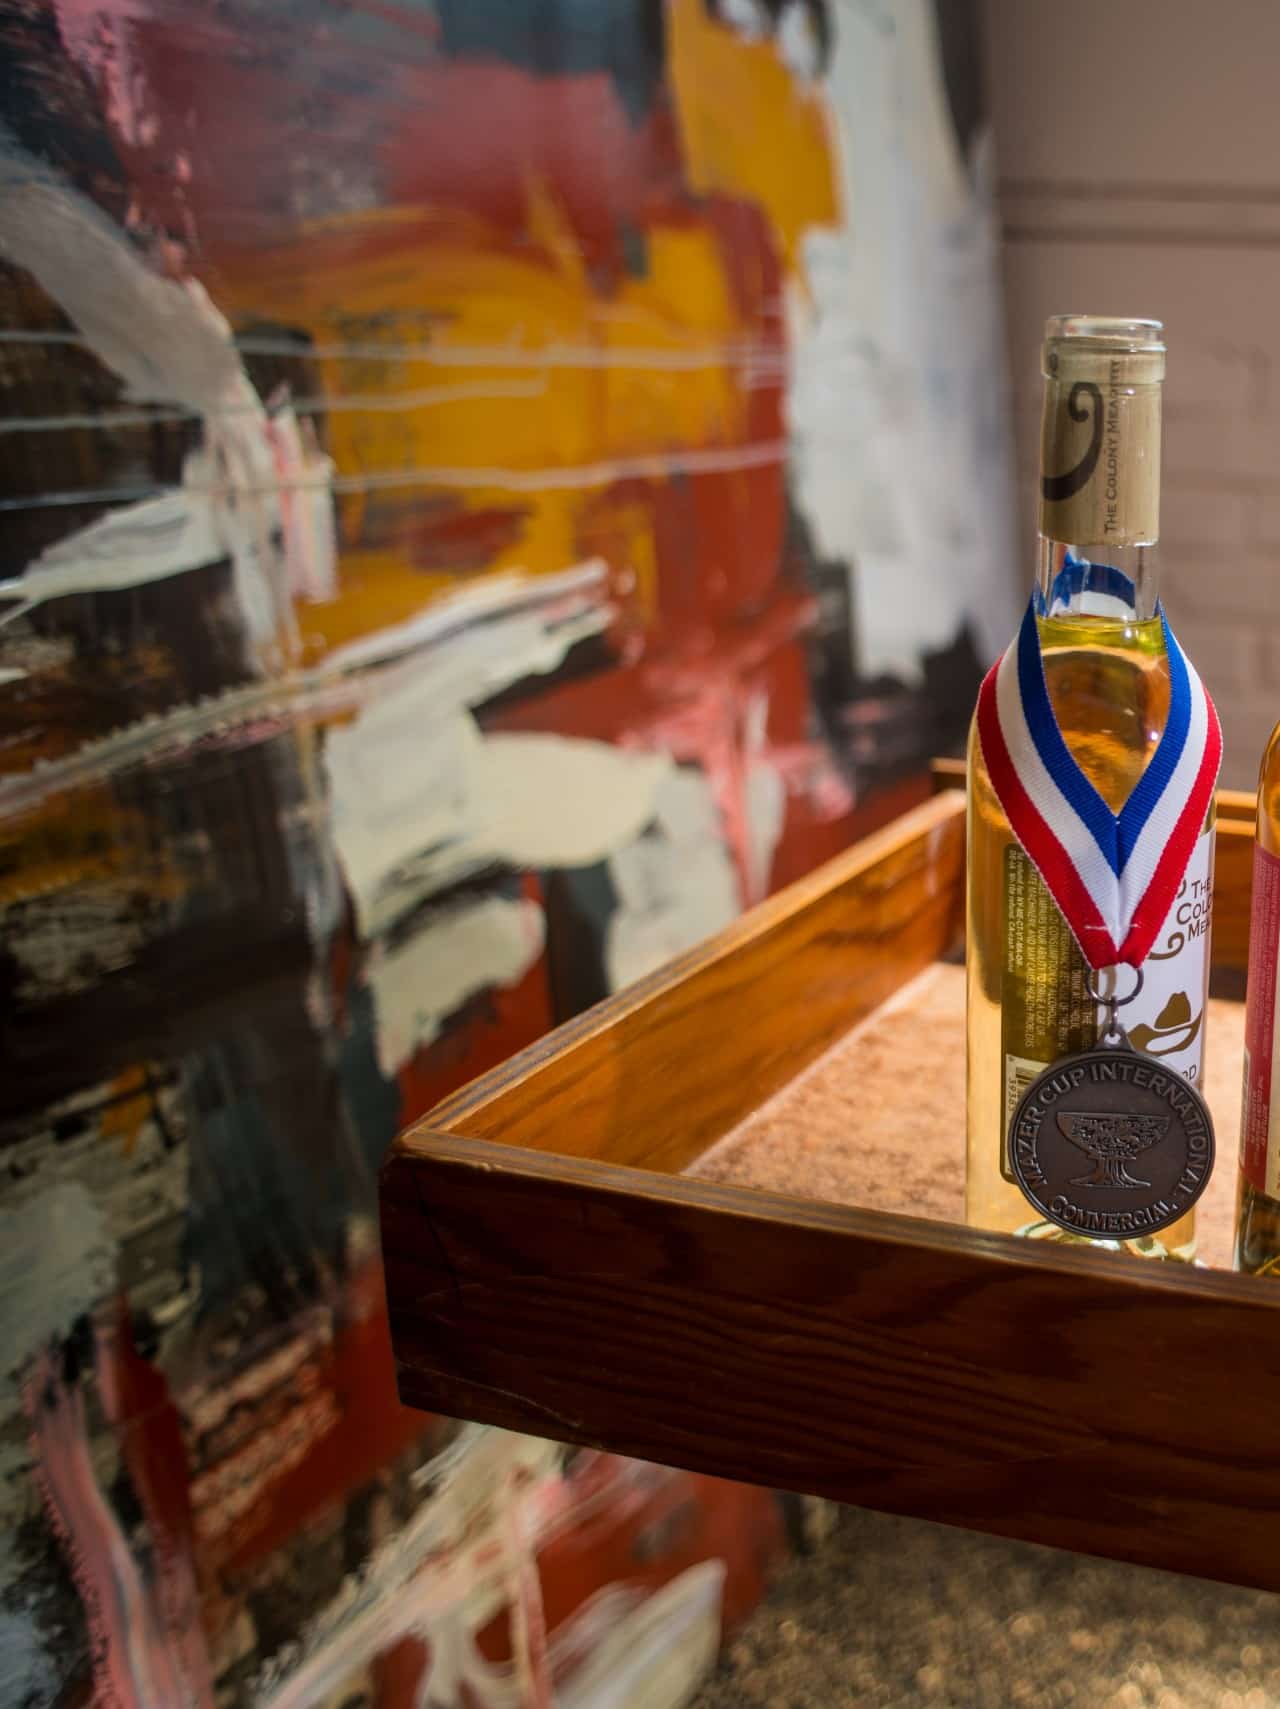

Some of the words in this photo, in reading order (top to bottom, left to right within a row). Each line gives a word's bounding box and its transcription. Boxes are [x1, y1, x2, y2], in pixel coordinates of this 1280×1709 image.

[1105, 443, 1120, 502] COLONY
[1104, 506, 1118, 534] THE
[1038, 1066, 1090, 1104] CUP
[1090, 1061, 1208, 1202] INTERNATIONAL
[1050, 1195, 1179, 1232] COMMERCIAL
